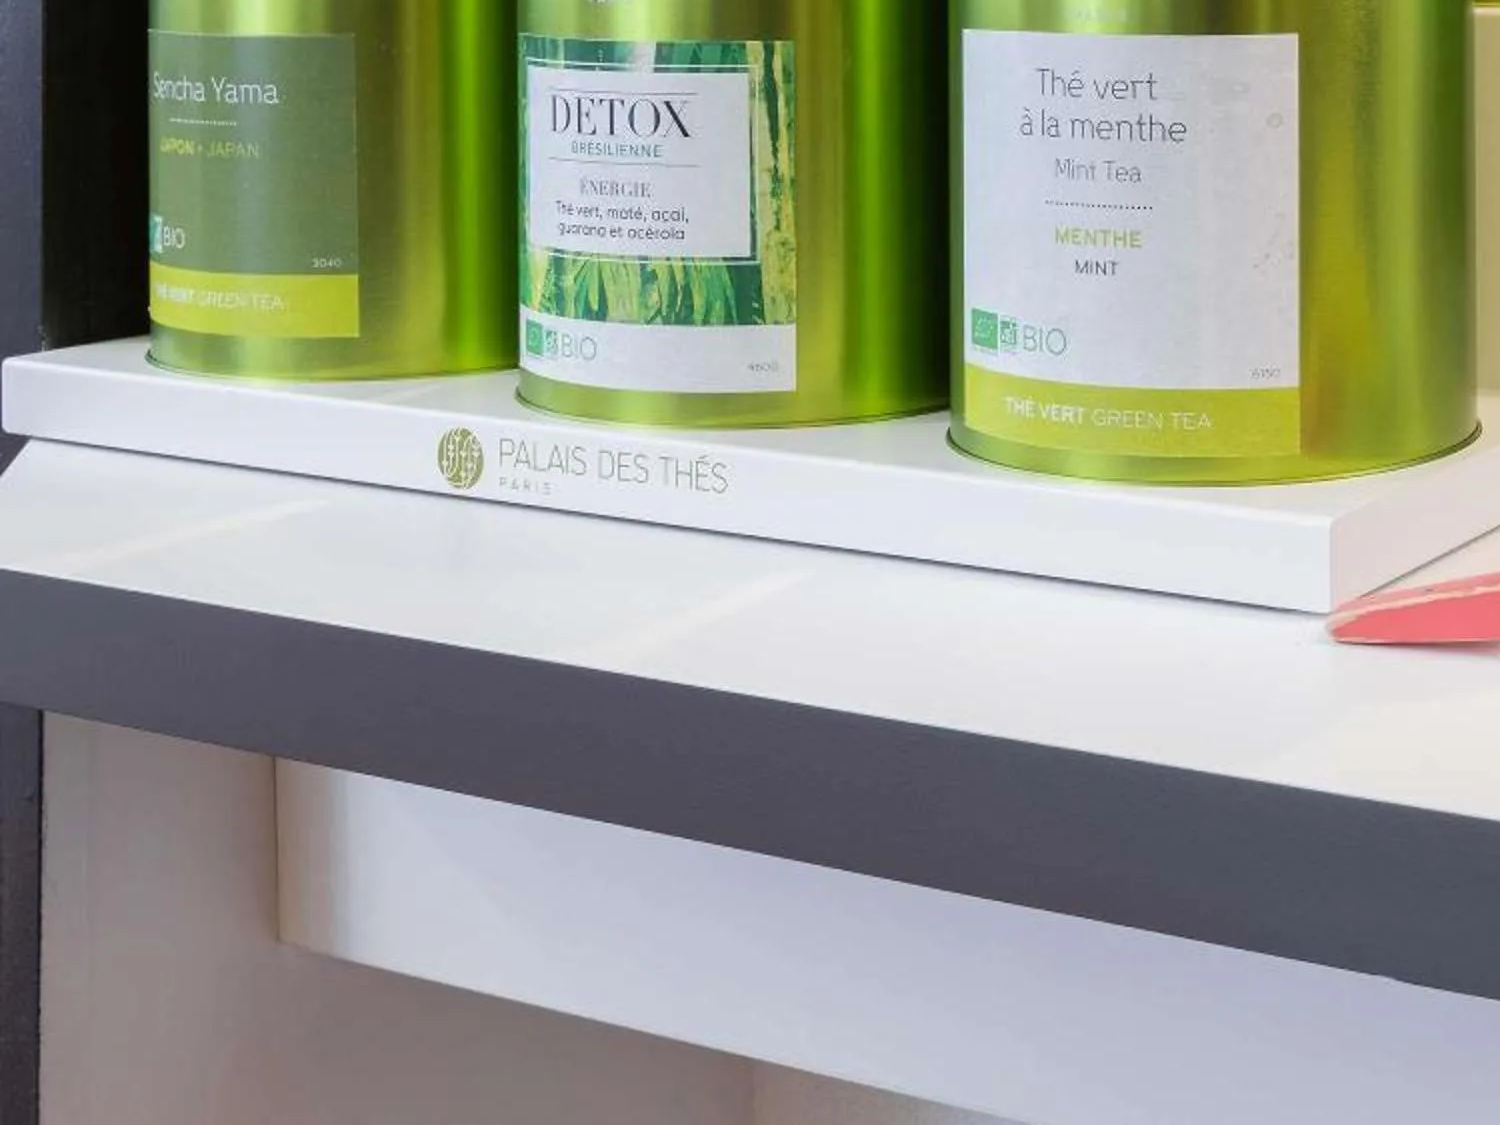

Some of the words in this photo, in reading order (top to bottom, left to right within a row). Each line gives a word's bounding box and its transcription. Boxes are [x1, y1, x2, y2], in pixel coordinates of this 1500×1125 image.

[153, 70, 206, 103] Sencha
[211, 75, 280, 105] Yama
[1035, 68, 1085, 99] Thé
[1093, 72, 1159, 101] vert
[551, 93, 698, 139] DETOX
[1019, 106, 1035, 138] à
[1040, 109, 1061, 139] la
[1069, 113, 1188, 143] menthe
[570, 139, 664, 158] BRÉSILIENNE
[1054, 157, 1097, 182] Mint
[1103, 159, 1142, 184] Tea
[163, 225, 187, 249] BIO
[609, 225, 623, 238] et
[1053, 225, 1143, 250] MENTHE
[1074, 259, 1119, 276] MINT
[561, 333, 598, 361] BIO
[1022, 324, 1067, 356] BIO
[1004, 395, 1038, 421] THÉ
[1039, 404, 1086, 425] VERT
[1091, 408, 1164, 429] GREEN
[1171, 411, 1213, 431] TEA
[499, 438, 587, 476] PALAIS
[598, 450, 650, 484] DES
[660, 455, 730, 495] THÉS
[499, 476, 552, 495] PARIS
